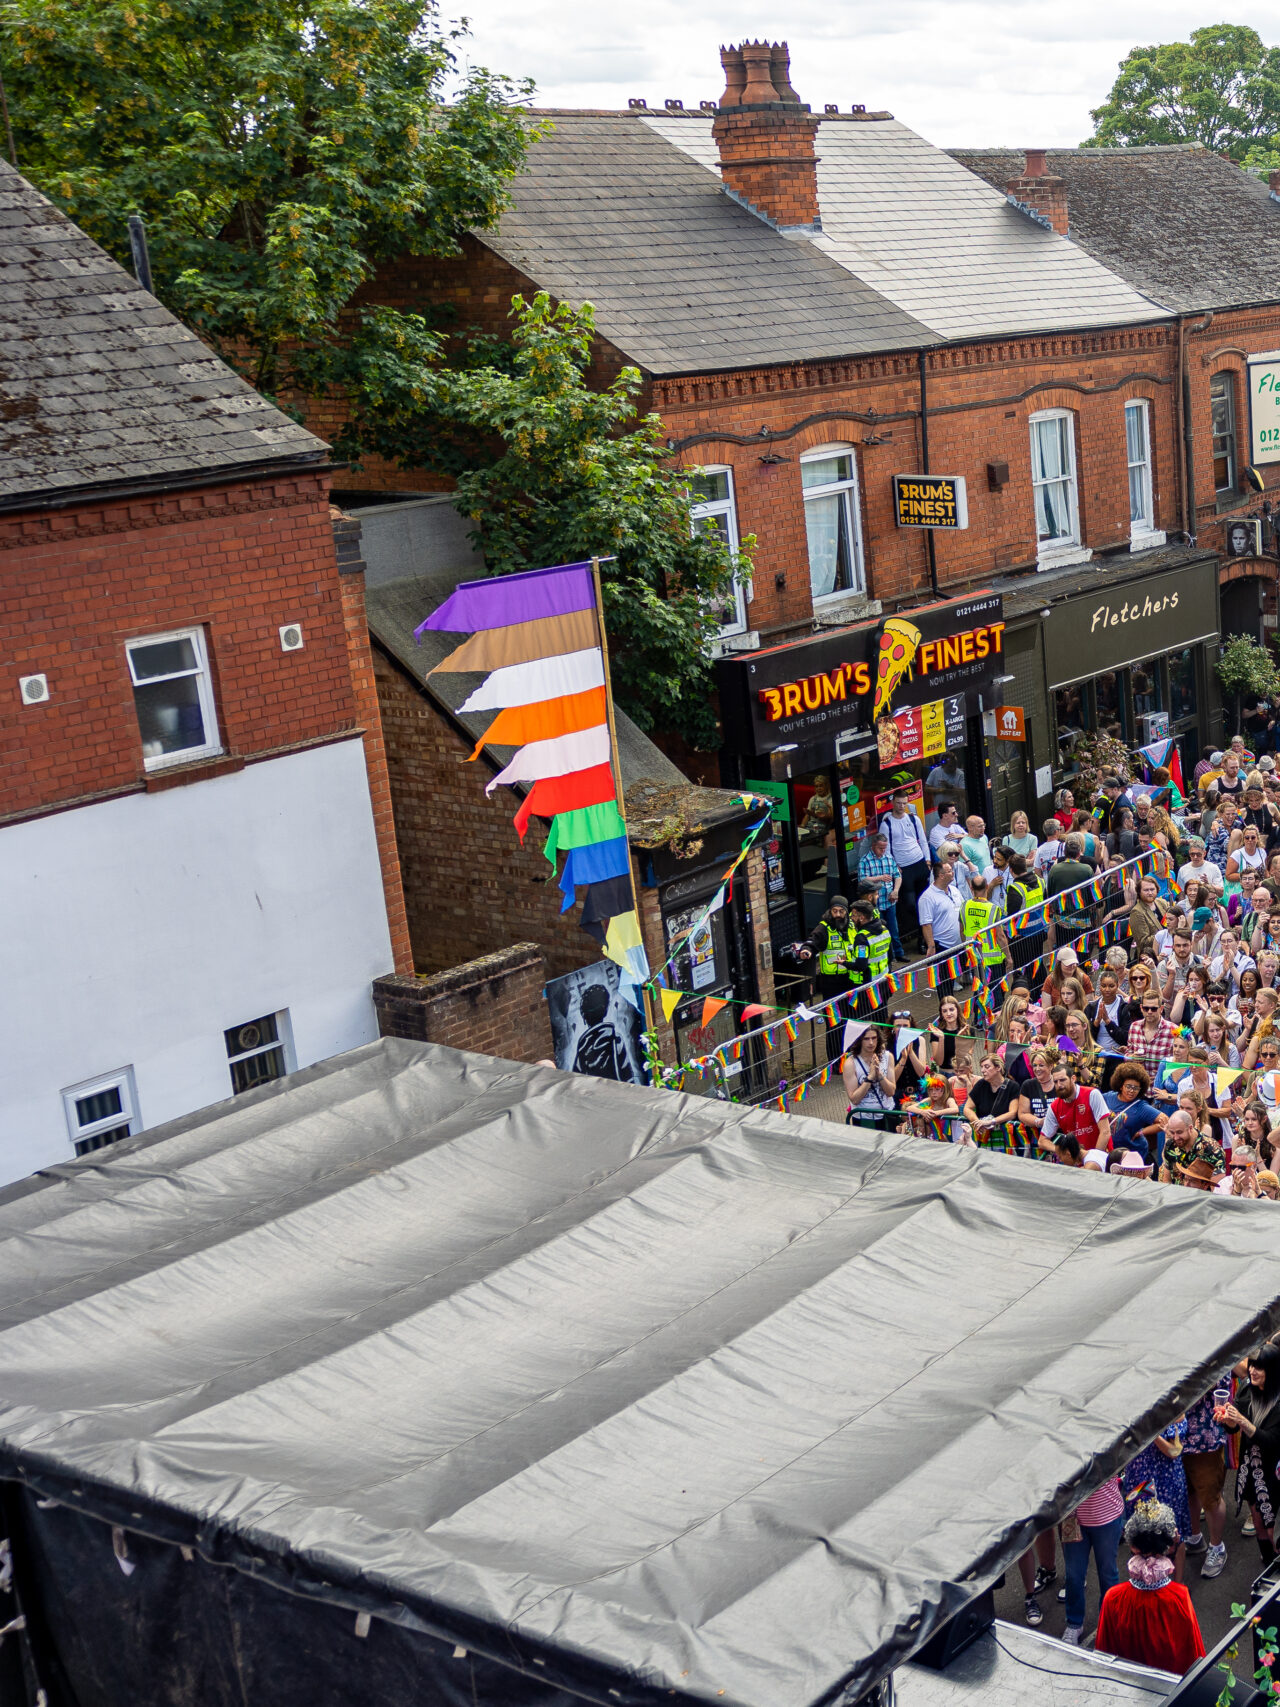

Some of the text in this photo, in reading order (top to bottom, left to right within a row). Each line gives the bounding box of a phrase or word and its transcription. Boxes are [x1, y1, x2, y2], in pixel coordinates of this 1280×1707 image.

[899, 481, 954, 500] BRUM'S
[899, 500, 955, 517] FINEST
[901, 516, 919, 524] 0121
[920, 517, 939, 525] 4444
[956, 599, 1000, 617] 0121 4444 317
[1091, 592, 1179, 633] Fletchers
[917, 621, 1005, 675] FINEST
[750, 664, 756, 673] 3
[929, 662, 985, 687] NOW TRY THE BEST
[760, 662, 871, 721] BRUM'S
[929, 704, 937, 720] 3
[950, 698, 959, 715] 3
[778, 701, 860, 734] YOU'VE TRIED THE BEST
[905, 710, 914, 728] 3
[945, 715, 965, 726] X-LARGE
[902, 728, 918, 737] SMALL
[925, 722, 941, 731] LARGE
[926, 729, 942, 738] PIZZAS
[947, 723, 963, 733] PIZZAS
[1000, 729, 1011, 737] JUST
[902, 736, 918, 745] PIZZAS
[947, 736, 964, 746] £24.99
